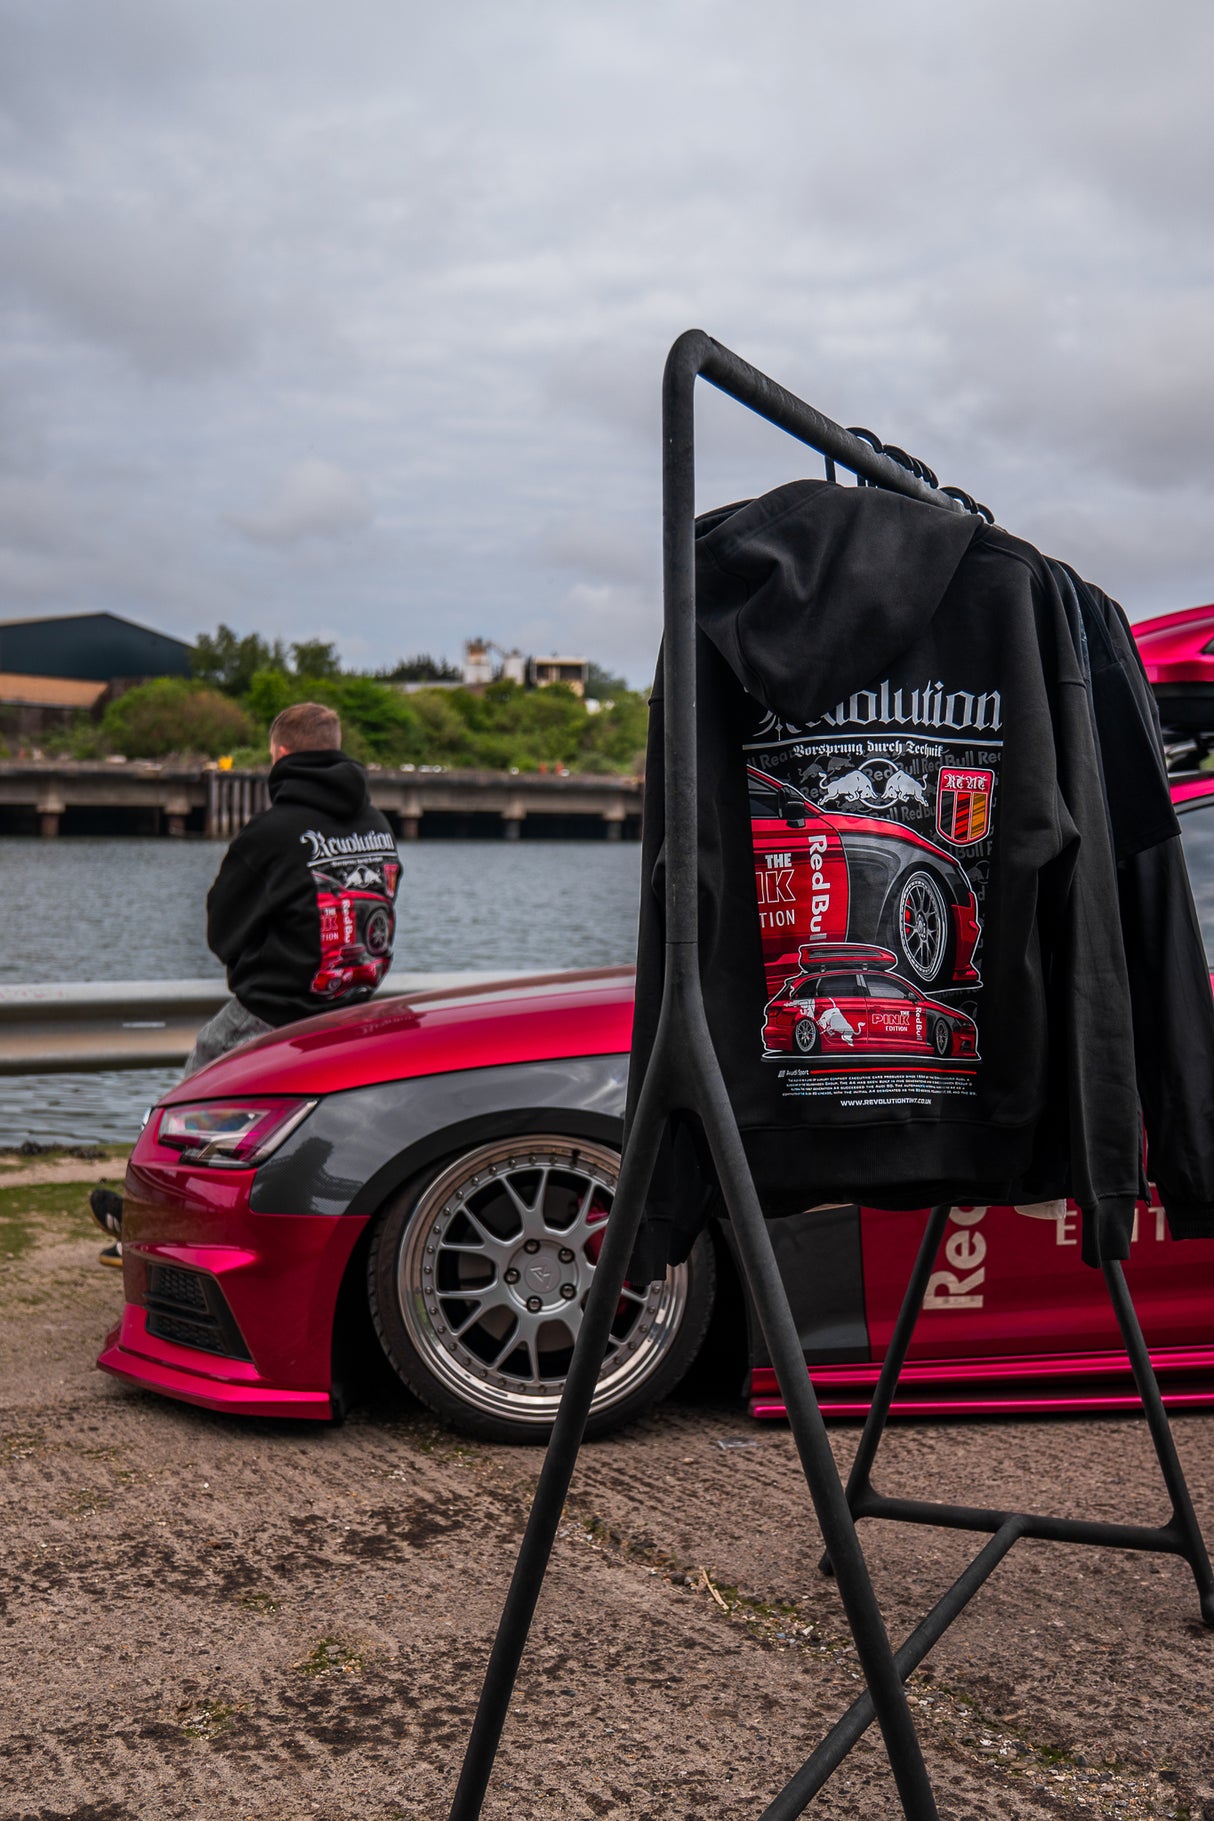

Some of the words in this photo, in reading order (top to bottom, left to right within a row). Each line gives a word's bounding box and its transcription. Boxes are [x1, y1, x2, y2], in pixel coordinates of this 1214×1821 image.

[793, 742, 863, 757] Vorsprung
[867, 740, 903, 756] durch
[906, 740, 944, 758] Technik
[300, 829, 395, 860] Revolution
[764, 852, 793, 869] THE
[808, 835, 831, 891] Red
[759, 909, 796, 929] TION
[871, 1013, 910, 1026] PINK
[1056, 1206, 1166, 1246] EIT
